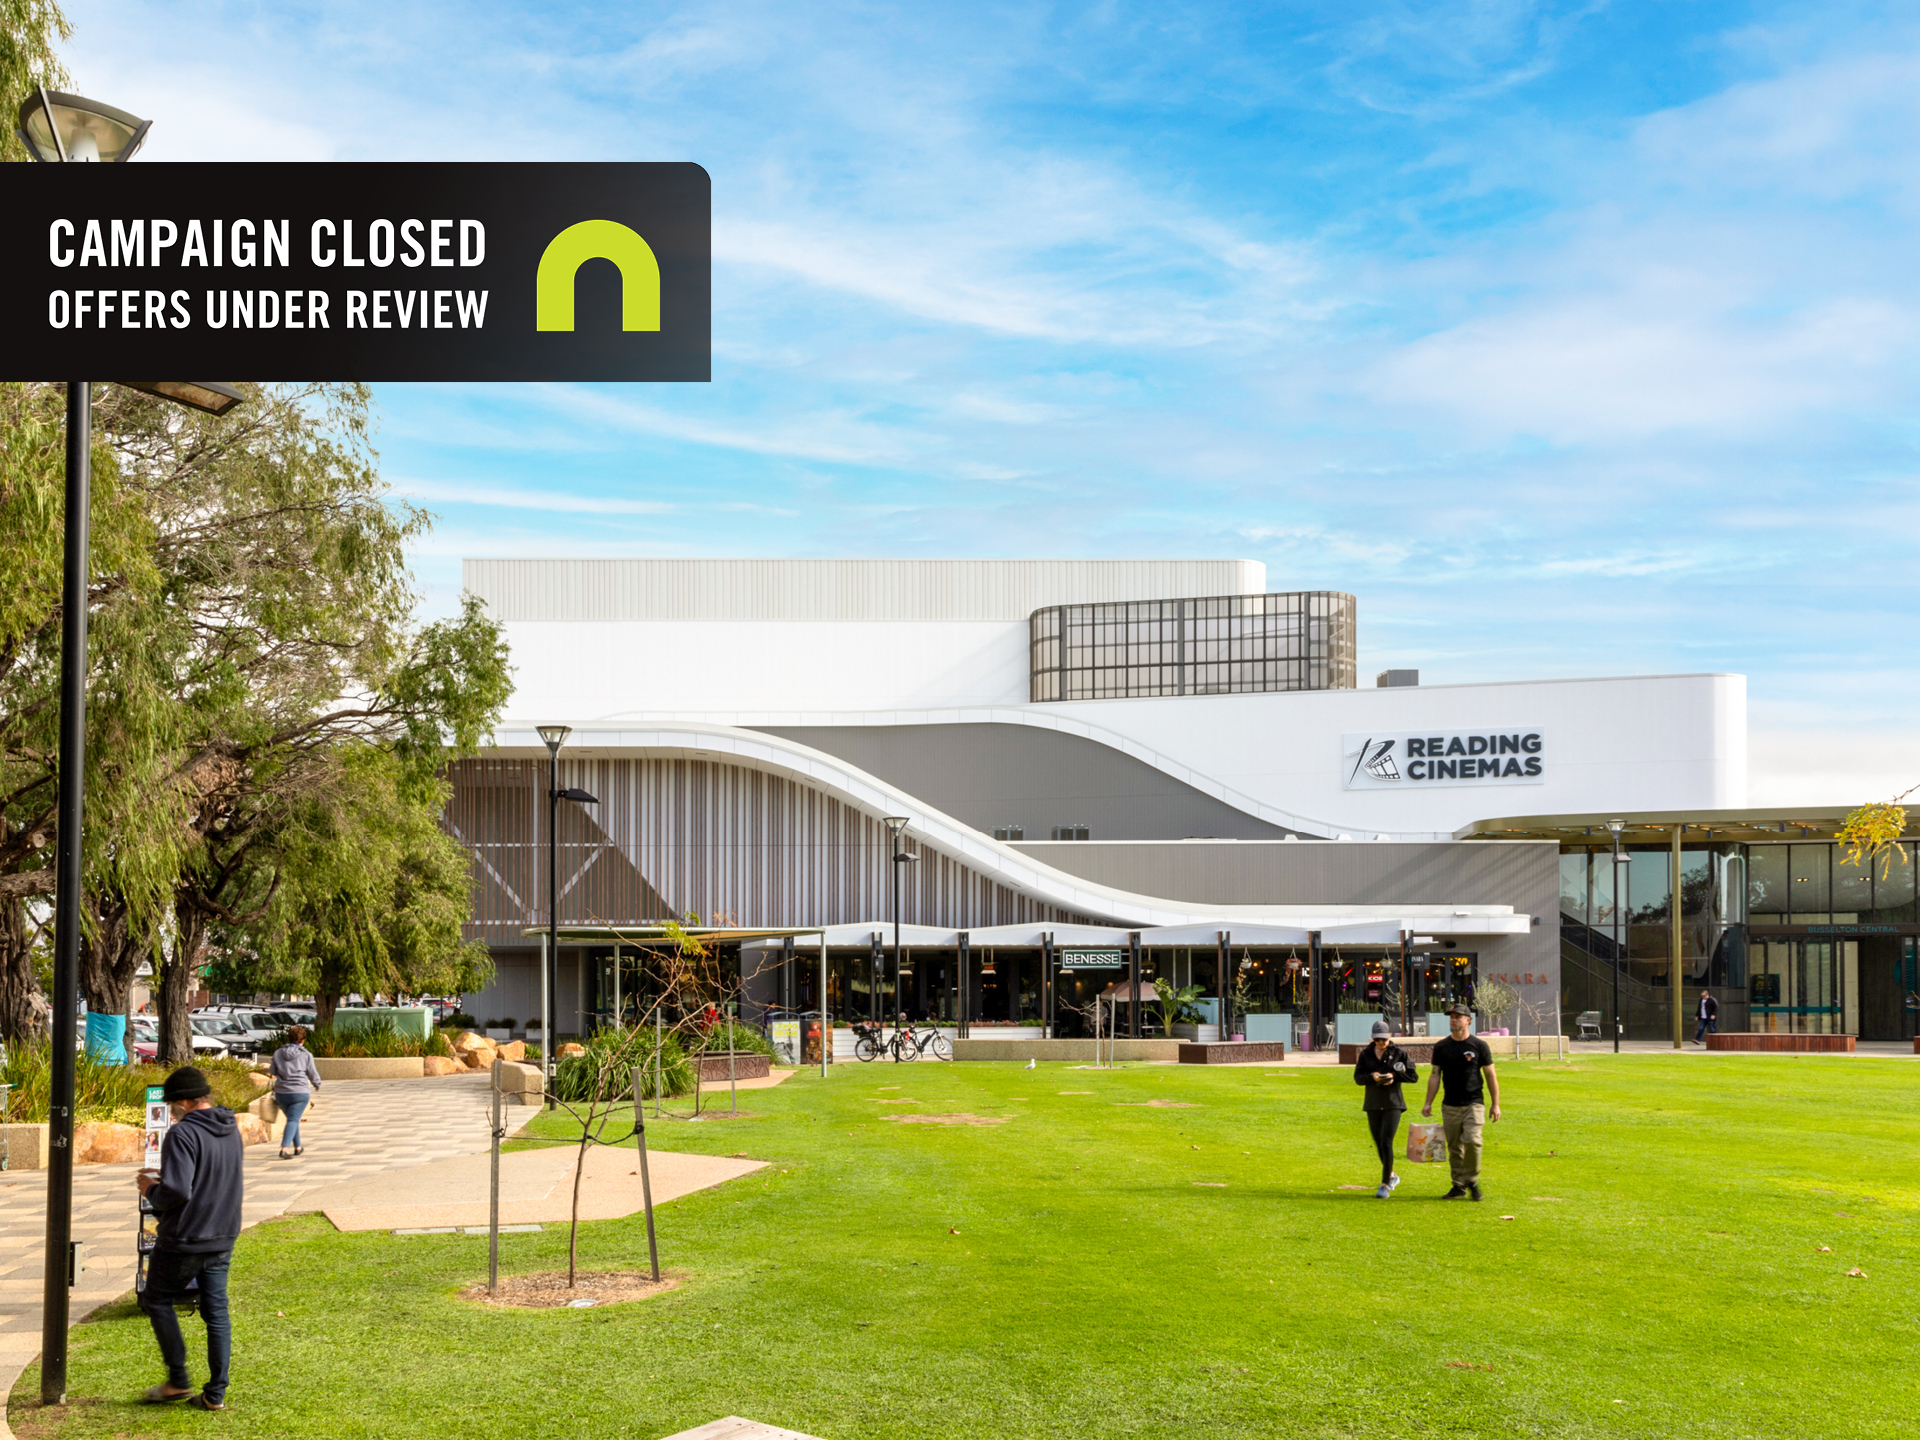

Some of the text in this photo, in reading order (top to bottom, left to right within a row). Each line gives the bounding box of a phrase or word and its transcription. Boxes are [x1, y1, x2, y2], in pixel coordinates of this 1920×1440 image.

[1407, 733, 1542, 758] READING
[1407, 757, 1543, 780] CINEMAS
[1807, 925, 1900, 934] BUSSELTON CENTRAL
[1065, 953, 1119, 964] BENESSE
[1489, 972, 1549, 985] INARA
